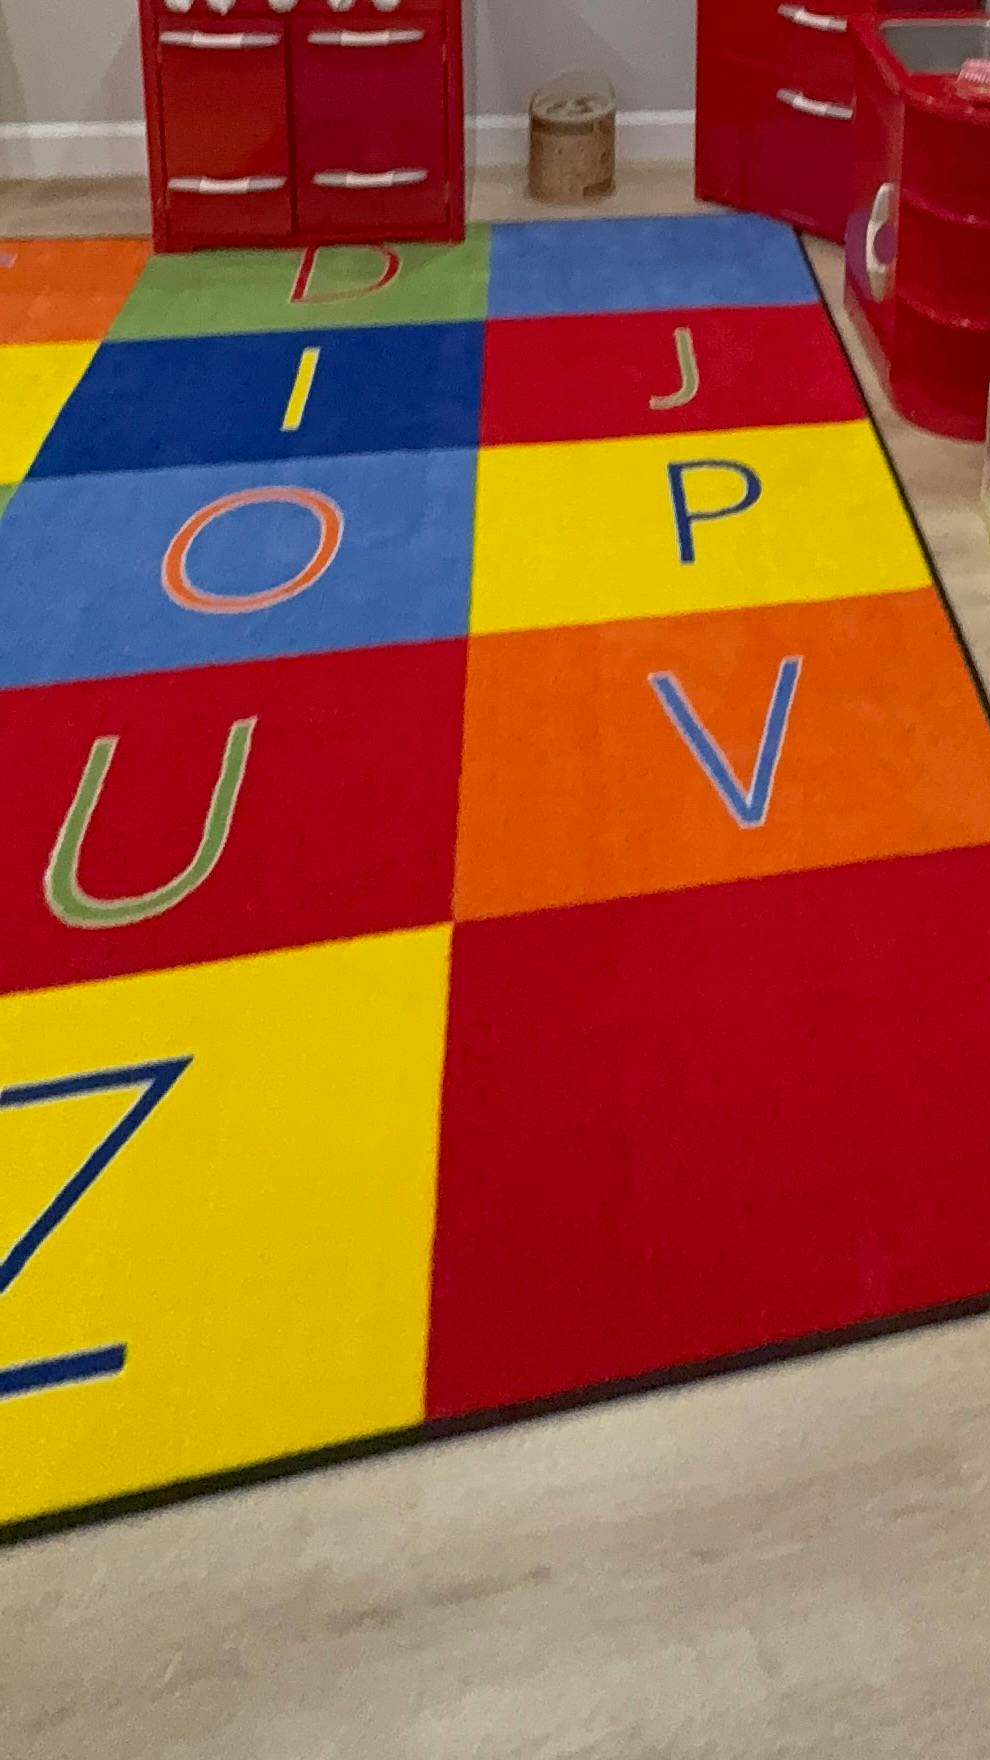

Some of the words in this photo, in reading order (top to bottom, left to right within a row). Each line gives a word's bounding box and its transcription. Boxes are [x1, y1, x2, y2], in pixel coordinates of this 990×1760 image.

[290, 244, 400, 304] D
[281, 347, 321, 431] I
[650, 328, 700, 410] J
[161, 485, 344, 614] O
[668, 458, 762, 564] P
[648, 655, 802, 827] V
[44, 716, 257, 929] U
